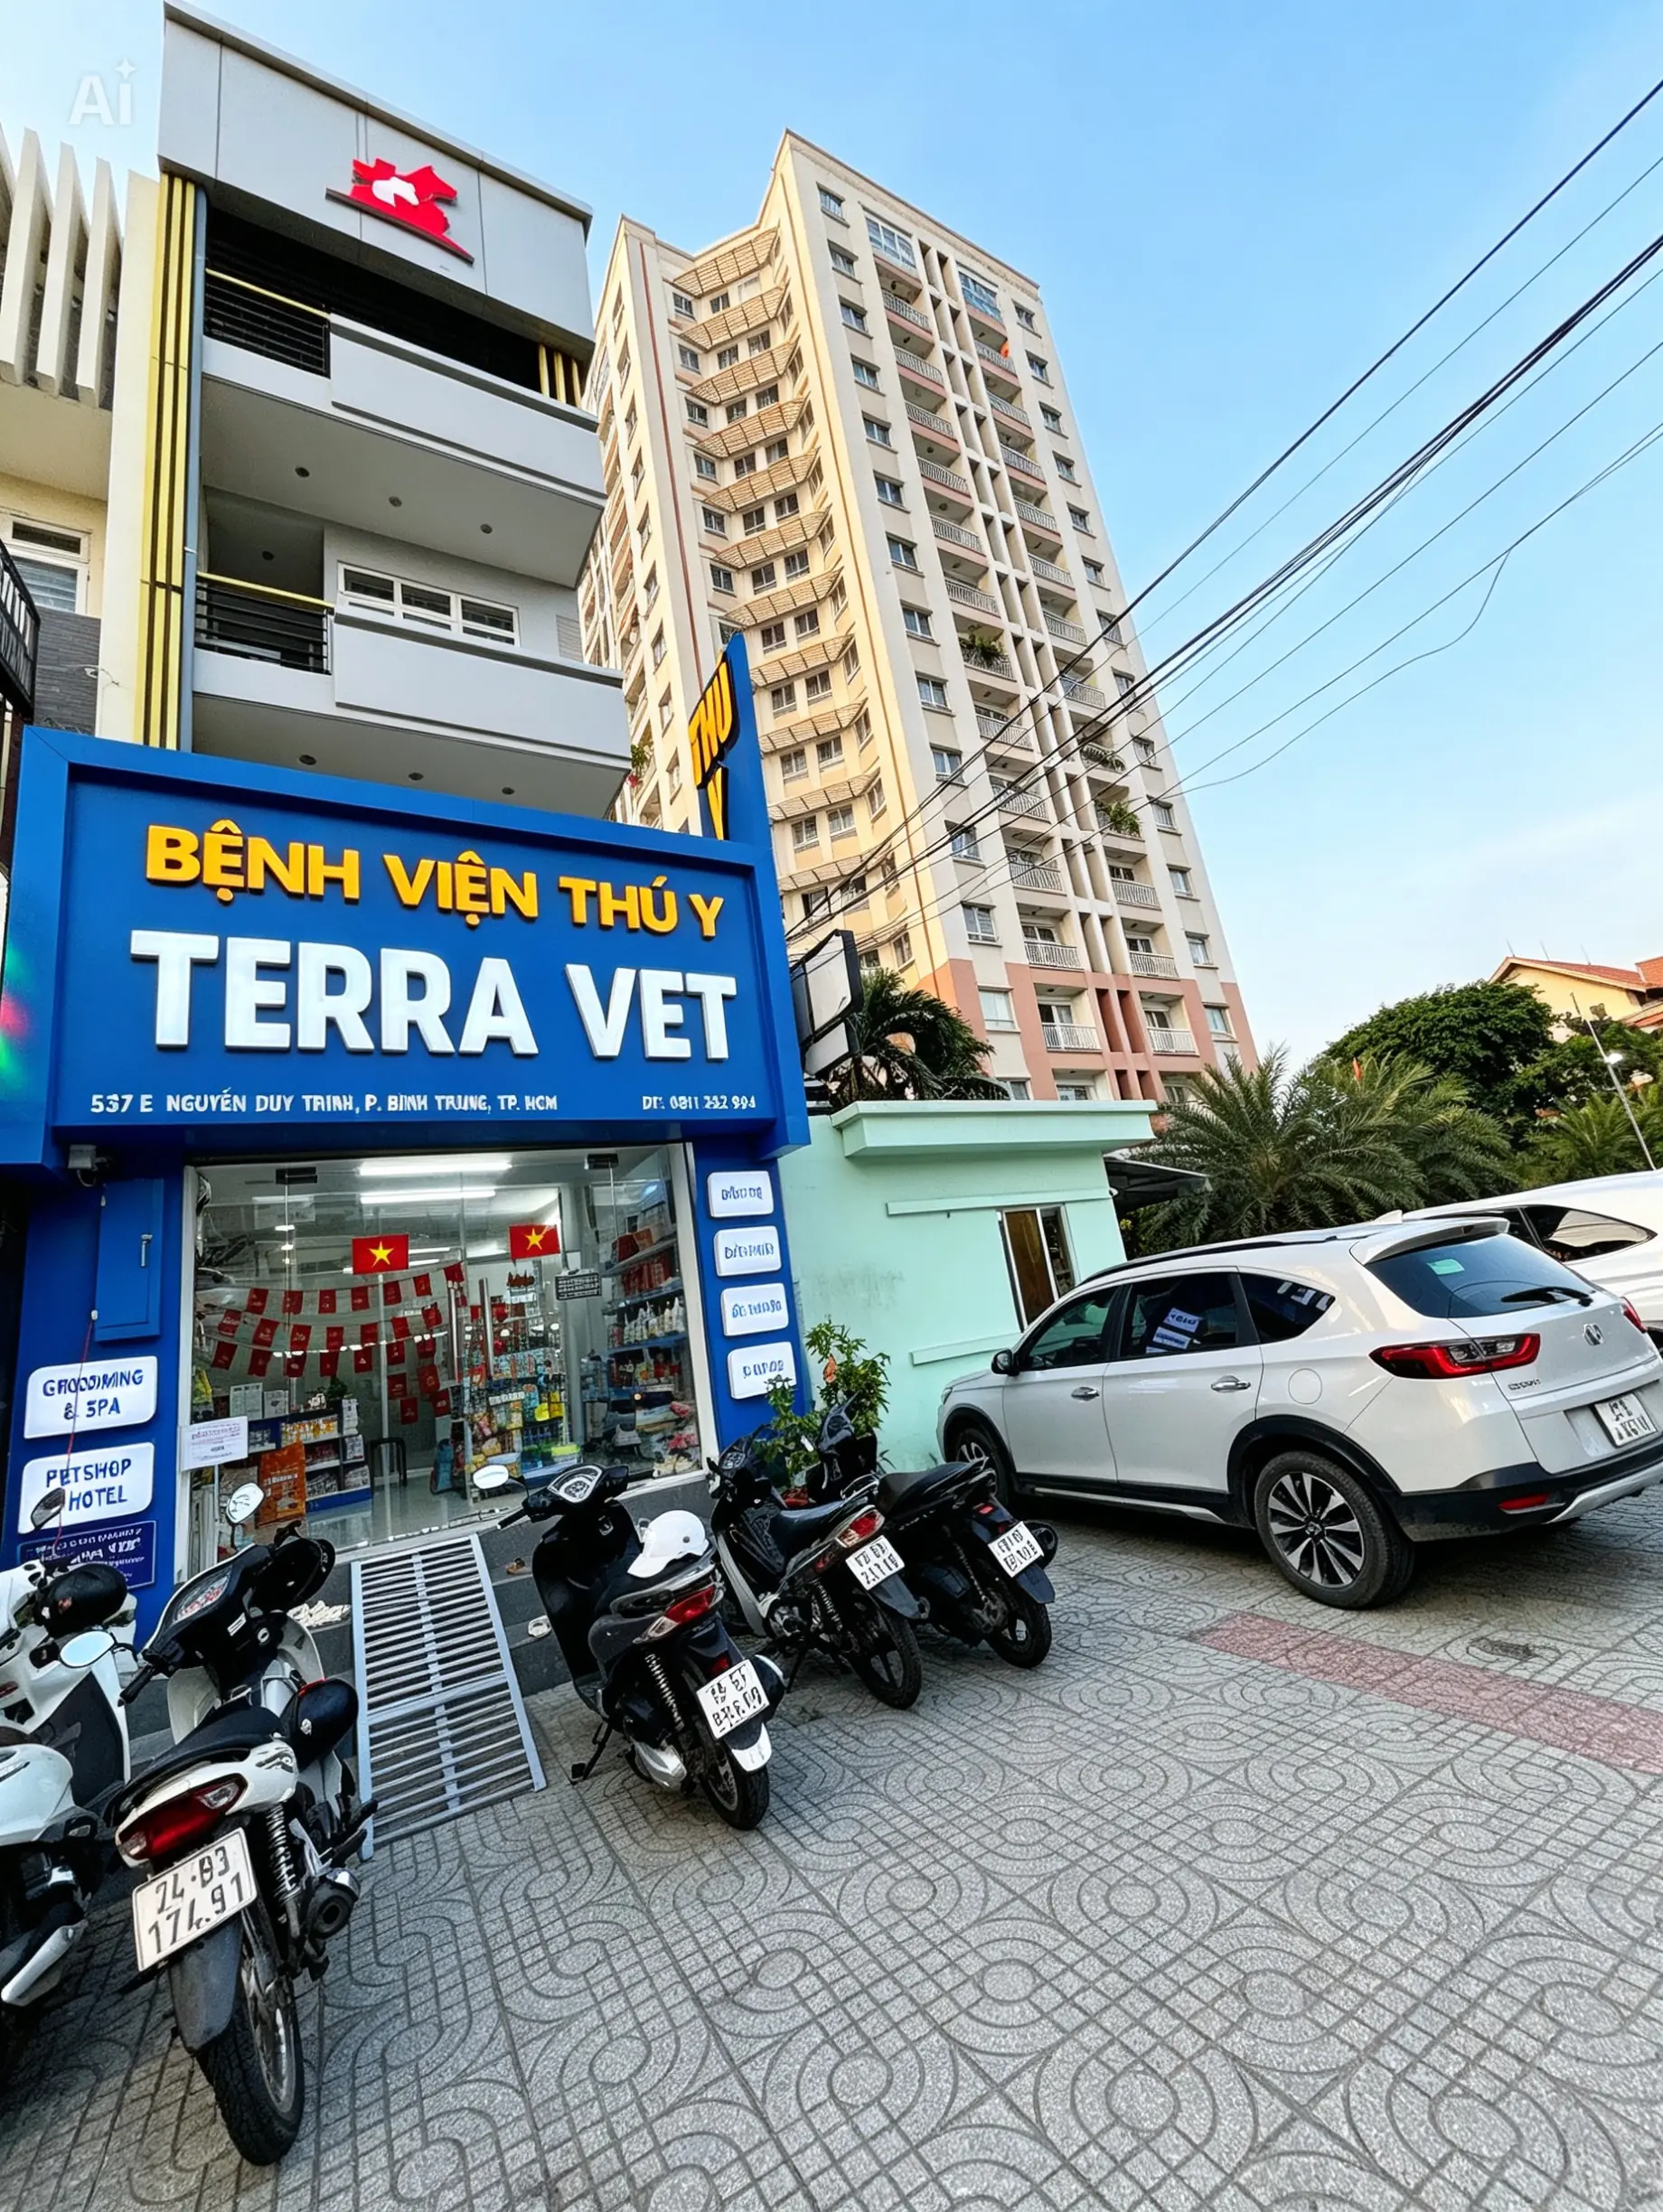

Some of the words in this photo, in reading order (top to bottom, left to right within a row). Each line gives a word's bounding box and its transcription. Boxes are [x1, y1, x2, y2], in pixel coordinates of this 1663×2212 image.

[146, 819, 360, 905] BỆNH
[383, 850, 539, 928] VIỆN
[559, 876, 678, 933] THÚ
[689, 893, 724, 938] Y
[130, 929, 540, 1056] TERRA
[566, 963, 737, 1061] VET
[139, 1094, 153, 1112] E
[255, 1094, 294, 1112] DUY
[364, 1094, 382, 1111] P.
[524, 1094, 558, 1111] HCM
[86, 1397, 121, 1418] SPA
[46, 1458, 132, 1488] PETSHOP
[68, 1486, 127, 1512] HOTEL
